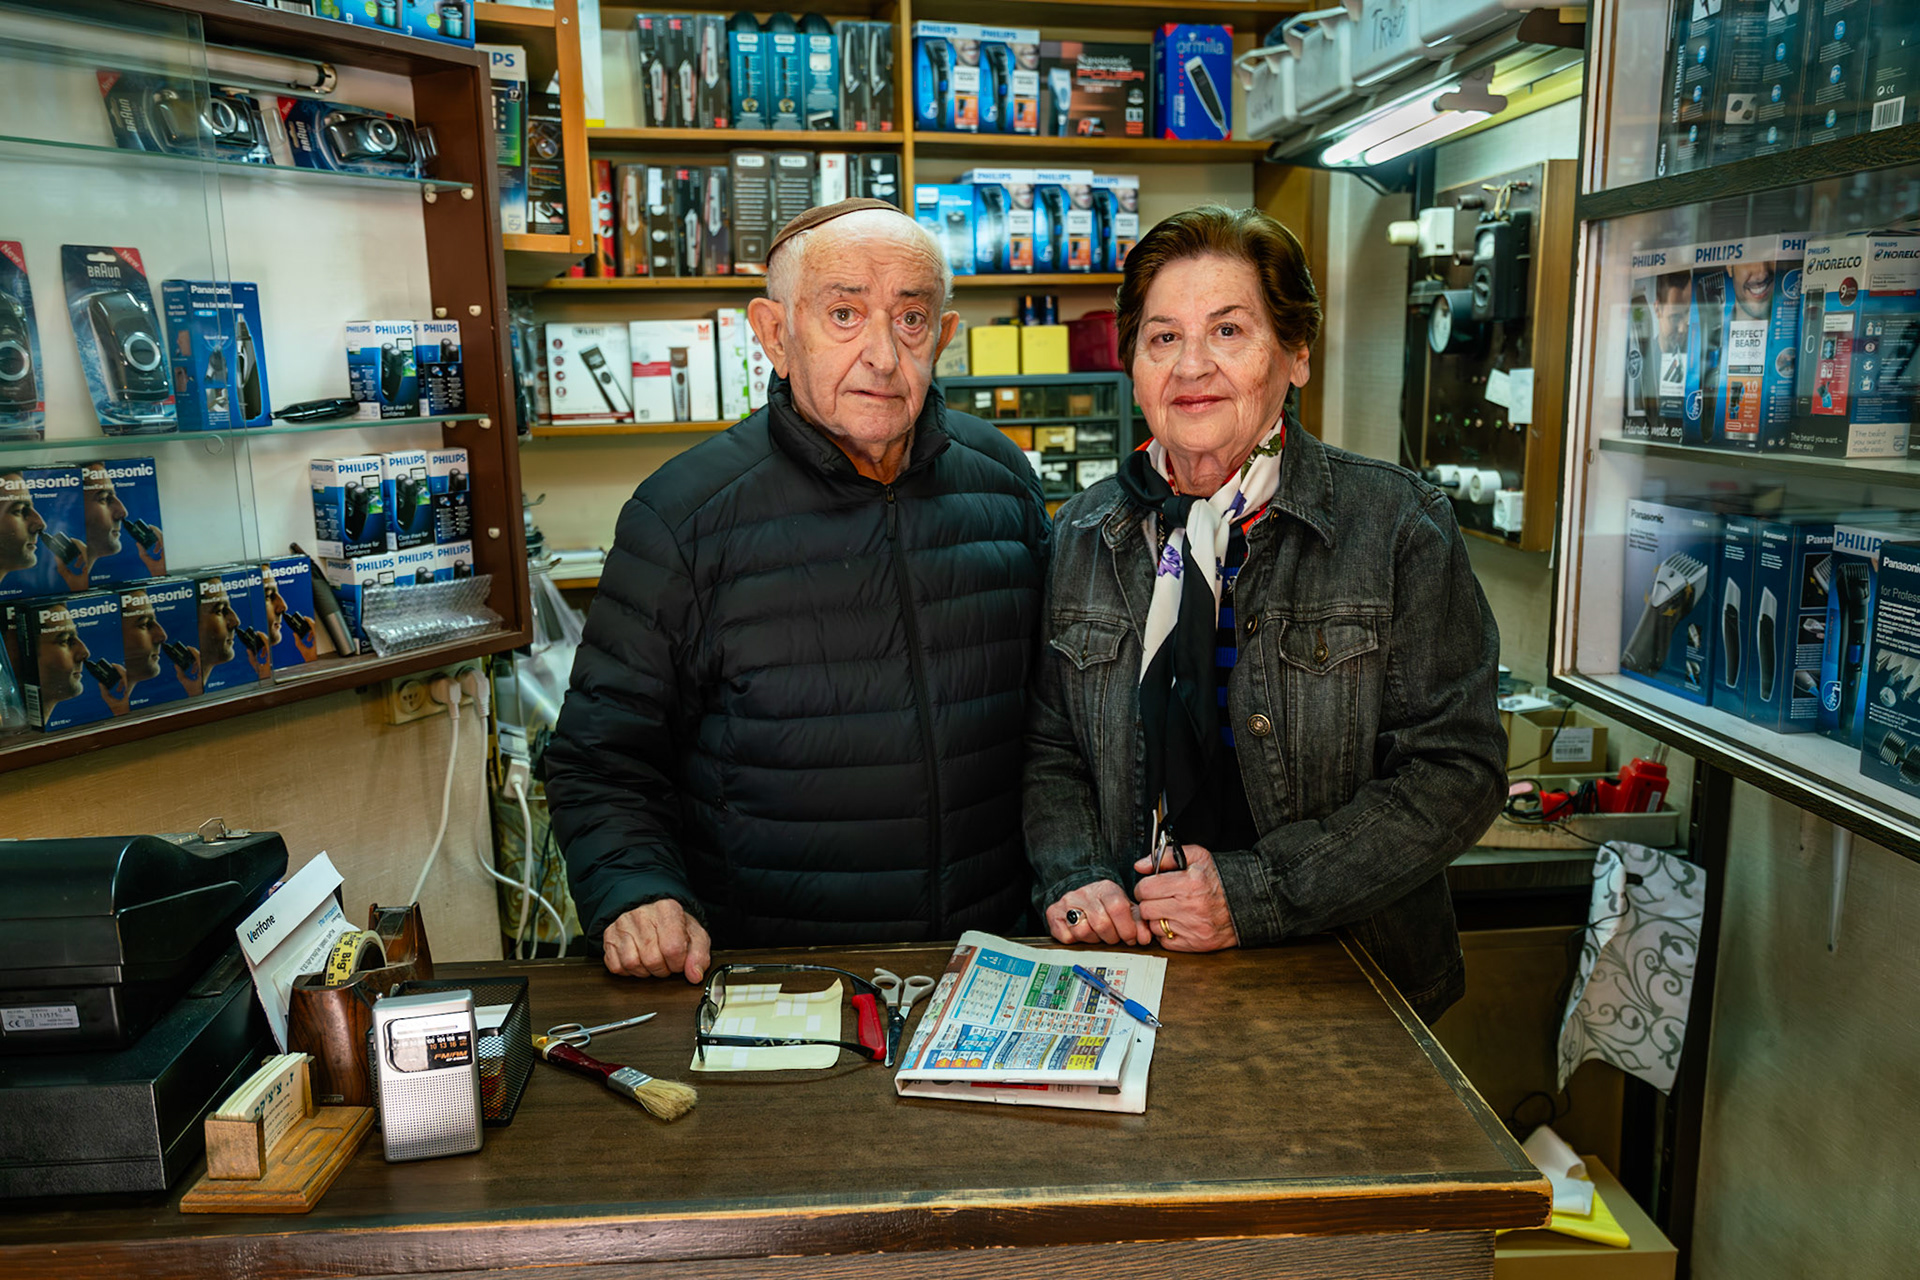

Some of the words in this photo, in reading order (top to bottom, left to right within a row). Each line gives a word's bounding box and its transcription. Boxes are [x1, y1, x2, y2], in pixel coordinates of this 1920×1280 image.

[921, 24, 957, 35] PHILIPS
[981, 29, 1017, 40] PHILIPS
[1674, 45, 1685, 96] TRIMMER
[102, 77, 116, 90] New
[509, 91, 520, 99] 17
[282, 101, 293, 115] New
[1672, 100, 1680, 123] HAIR
[120, 98, 136, 132] BRAUN
[295, 121, 311, 152] BRAUN
[1, 243, 21, 264] New
[1695, 243, 1744, 263] PHILIPS
[1807, 246, 1831, 255] PHILIPS
[121, 250, 140, 268] New
[1632, 253, 1666, 268] PHILIPS
[1815, 256, 1862, 271] NORELCO
[87, 263, 121, 278] BRAUN
[191, 285, 231, 295] Panasonic
[1840, 284, 1847, 299] 9
[346, 325, 370, 333] PHILIPS
[375, 325, 412, 334] PHILIPS
[424, 324, 458, 333] PHILIPS
[1731, 329, 1765, 339] PERFECT
[1735, 338, 1761, 348] BEARD
[1625, 419, 1649, 436] Haircuts
[1651, 422, 1669, 435] made
[1790, 432, 1799, 441] The
[1800, 433, 1815, 443] beard
[1815, 436, 1823, 445] you
[1823, 436, 1837, 444] want
[1789, 442, 1802, 450] made
[389, 454, 426, 467] PHILIPS
[432, 453, 466, 464] PHILIPS
[82, 463, 154, 481] Panasonic
[311, 463, 334, 472] PHILIPS
[338, 461, 379, 474] PHILIPS
[0, 474, 80, 490] Panasonic
[1630, 508, 1664, 524] Panasonic
[1726, 522, 1749, 534] Panasonic
[398, 533, 410, 541] Close
[410, 532, 422, 540] shave
[1763, 530, 1788, 541] Panasonic
[345, 543, 358, 551] Close
[358, 542, 371, 550] shave
[398, 538, 421, 547] confidence
[346, 548, 371, 558] confidence
[398, 551, 434, 564] PHILIPS
[438, 545, 471, 557] PHILIPS
[327, 561, 351, 571] PHILIPS
[356, 558, 394, 572] PHILIPS
[199, 574, 262, 595] Panasonic
[1881, 585, 1891, 596] for
[121, 586, 193, 608] Panasonic
[39, 600, 118, 624] Panasonic
[156, 604, 176, 613] Trimmer
[77, 619, 99, 628] Trimmer
[246, 914, 276, 944] Verifone
[337, 952, 351, 972] Big
[434, 1050, 468, 1060] FM/AM
